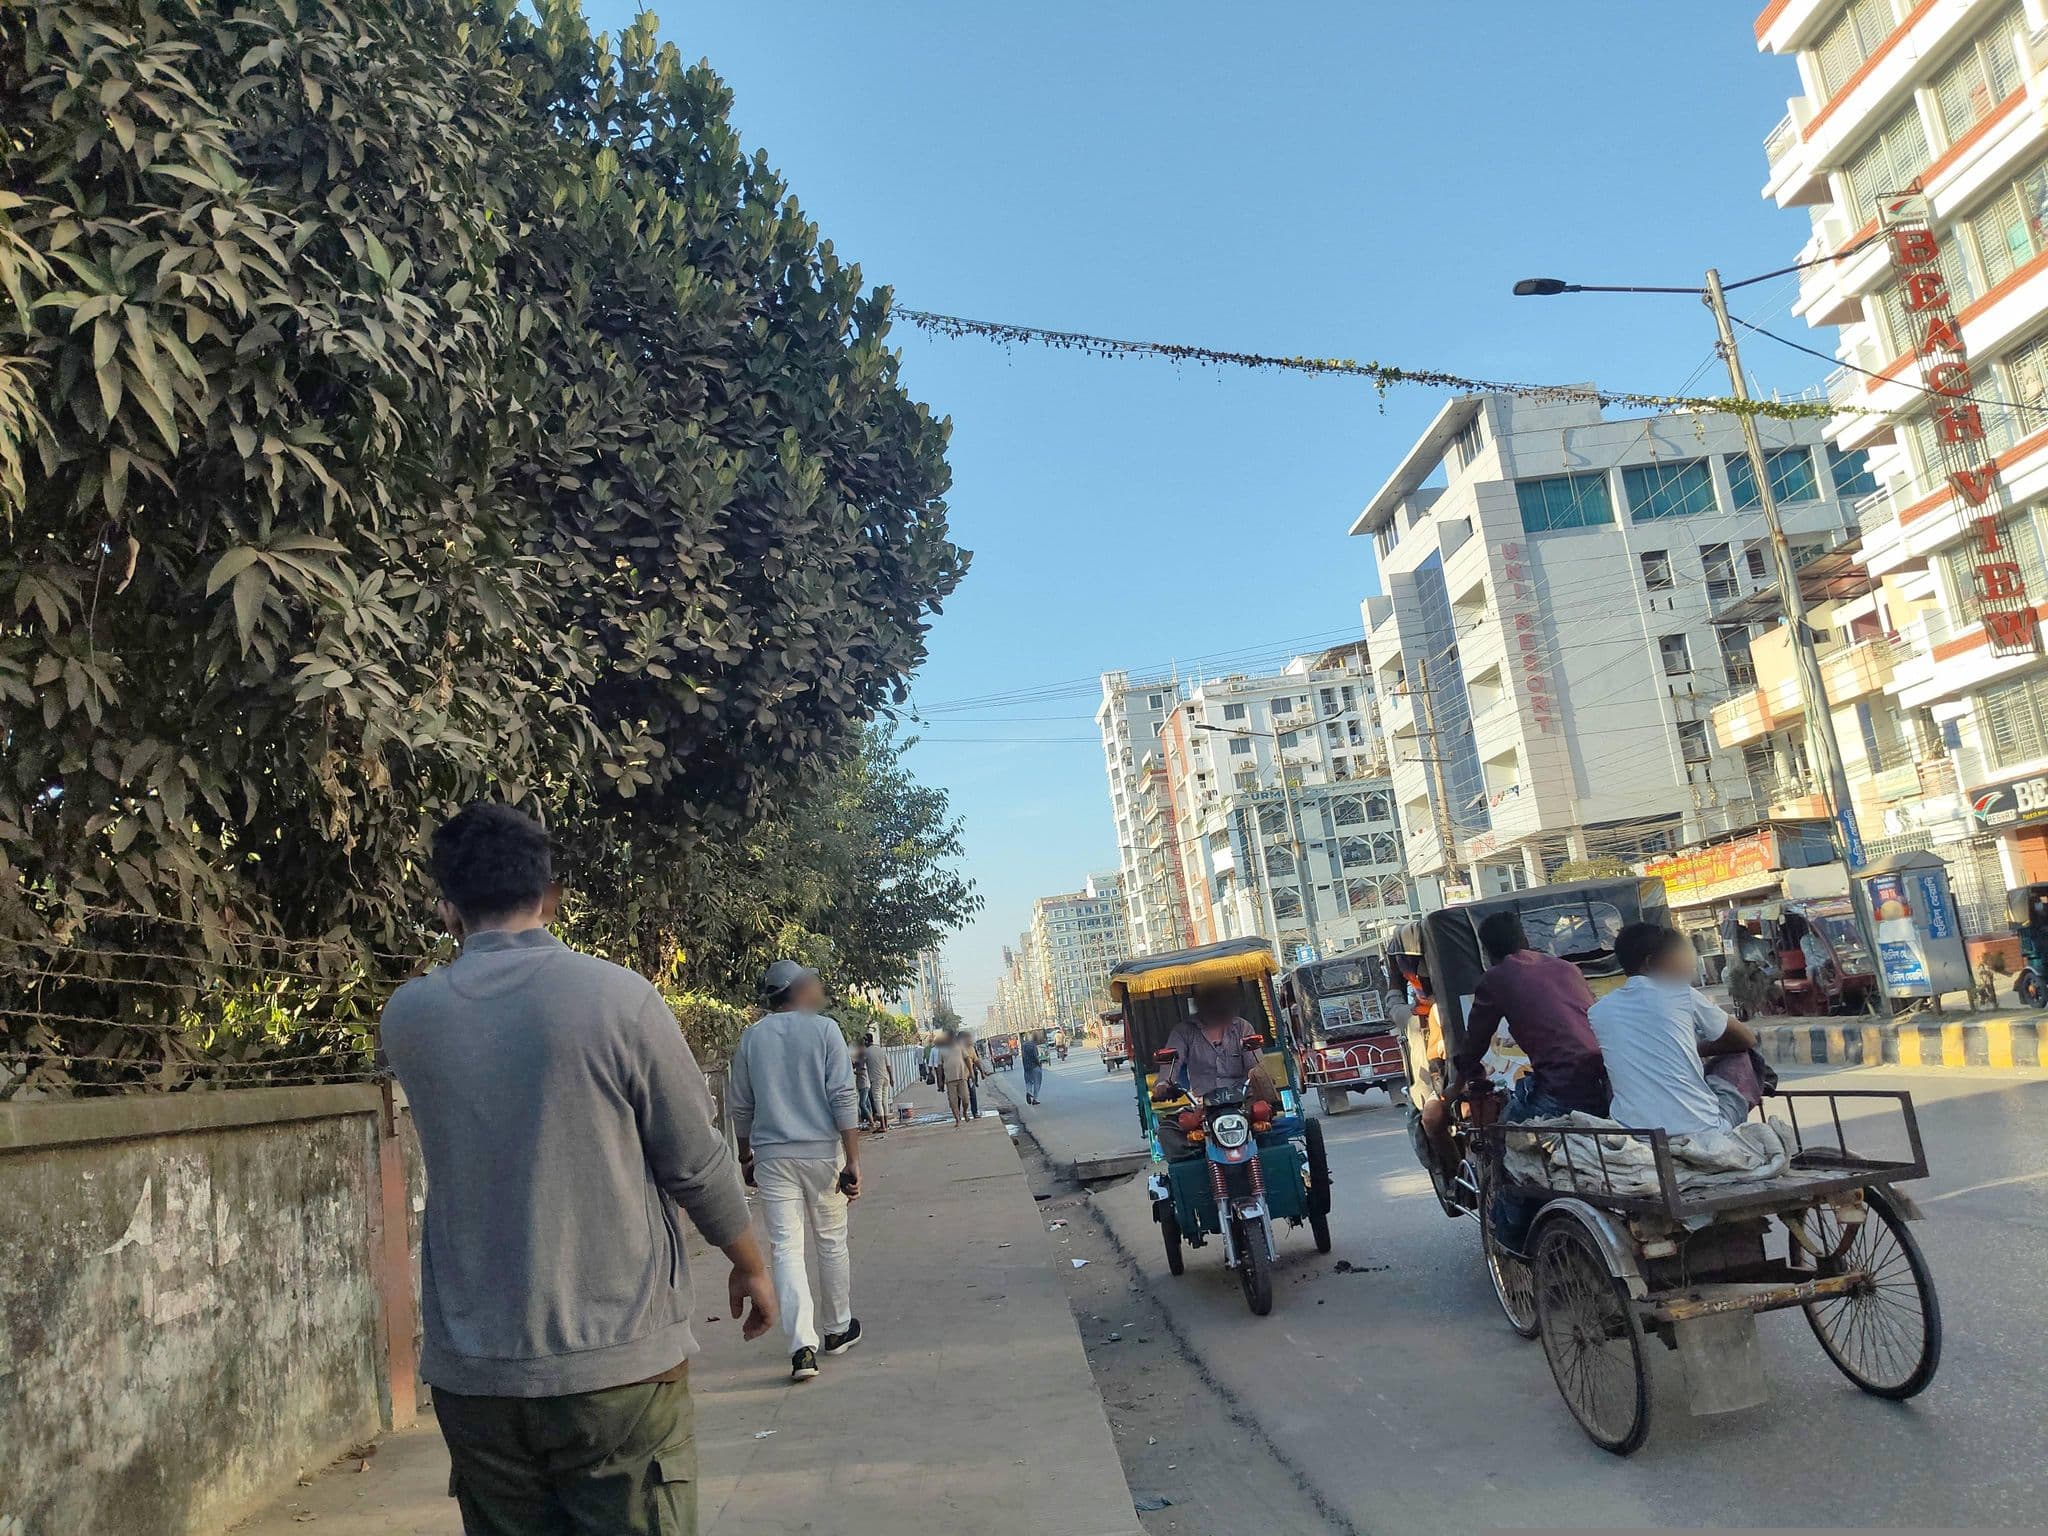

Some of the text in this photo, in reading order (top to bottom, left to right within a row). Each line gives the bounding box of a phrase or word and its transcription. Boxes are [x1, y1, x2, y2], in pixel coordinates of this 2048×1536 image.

[1895, 230, 2038, 648] BEACH VIEW
[1501, 542, 1550, 734] UNI RESORT
